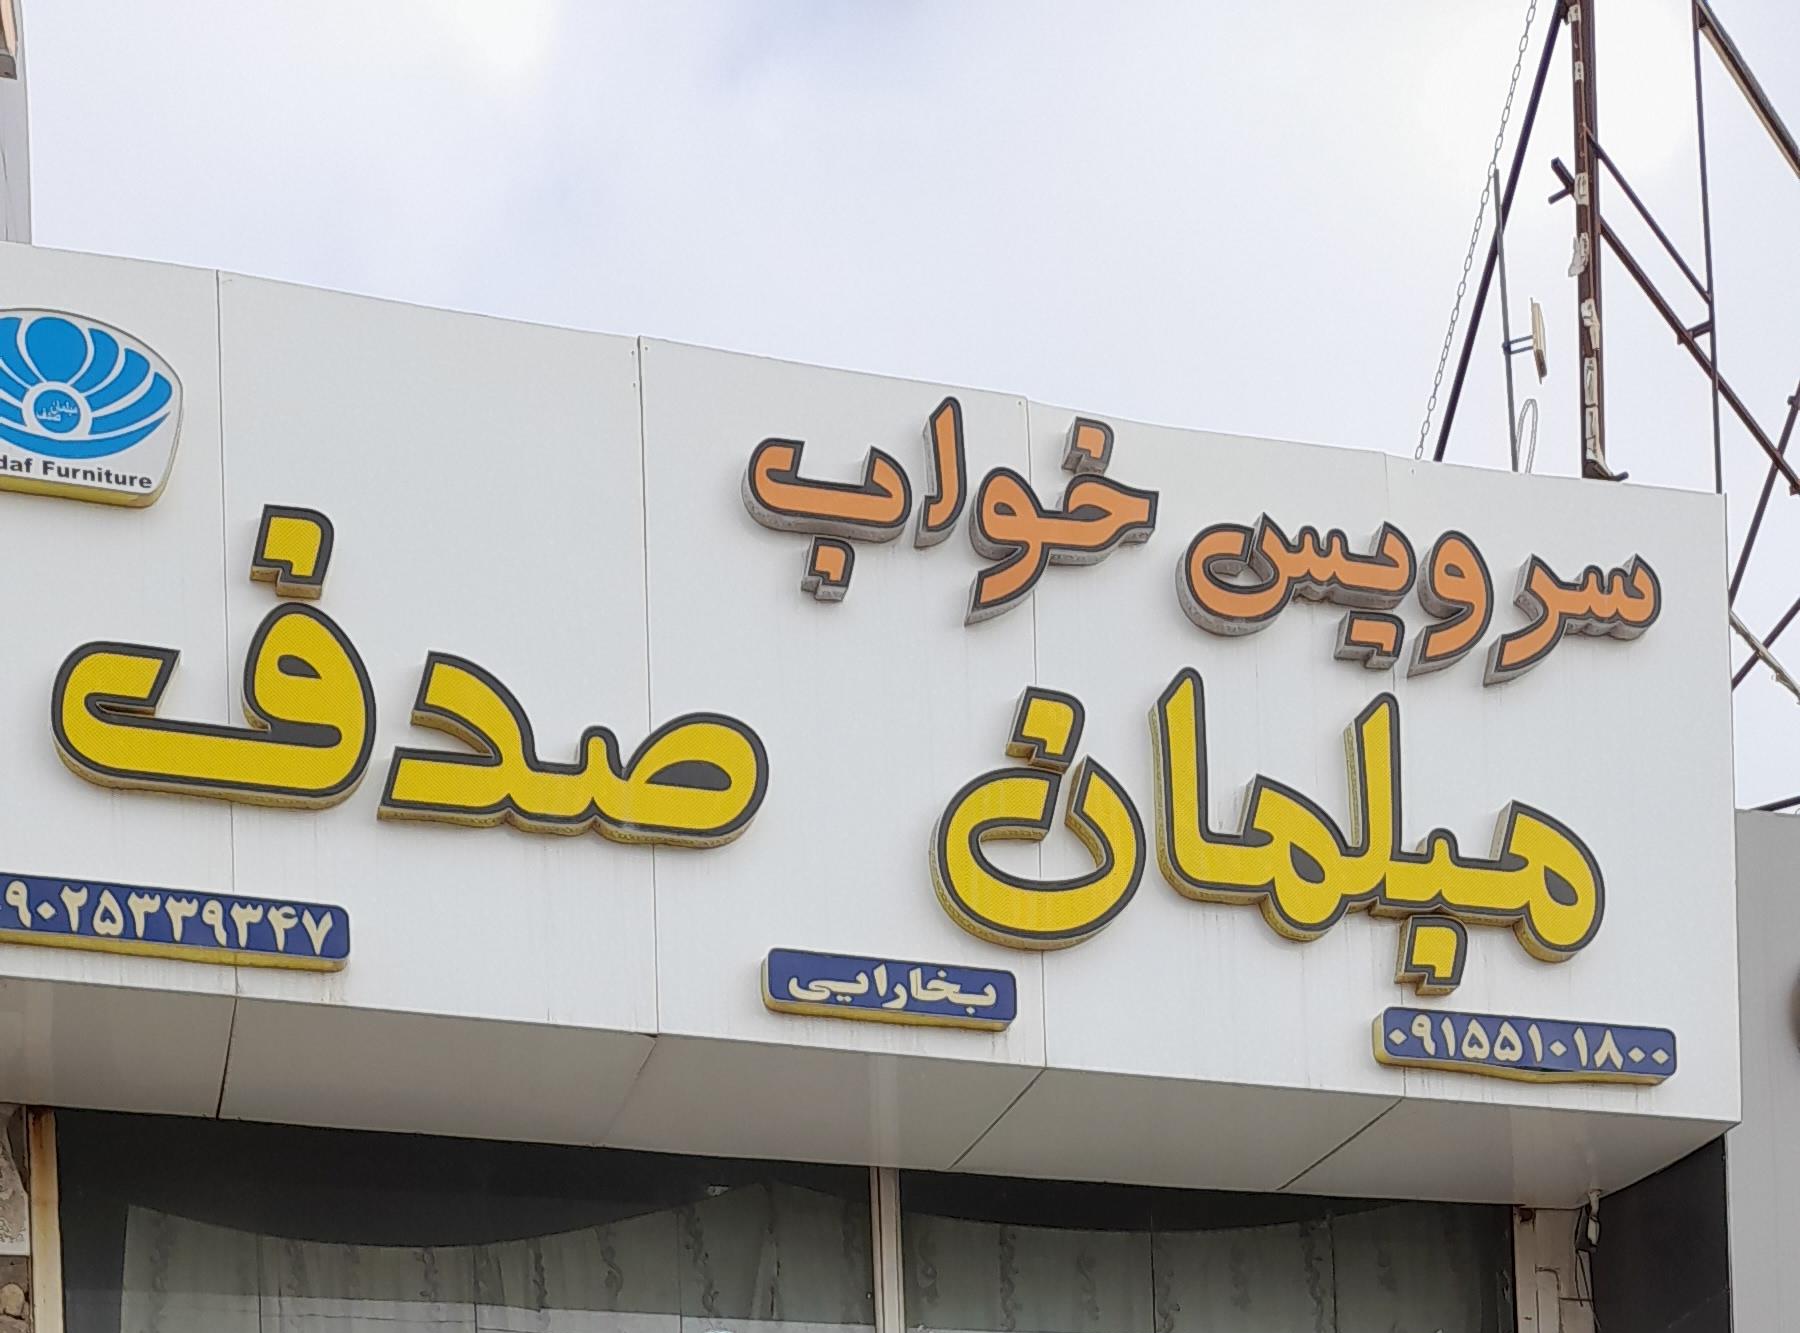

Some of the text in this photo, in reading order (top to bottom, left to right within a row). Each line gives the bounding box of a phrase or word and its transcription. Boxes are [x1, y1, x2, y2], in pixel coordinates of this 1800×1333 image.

[43, 460, 152, 489] Furniture
[744, 396, 1661, 682] سرویس خواب
[51, 505, 1605, 990] مبلمان صدف
[0, 880, 333, 955] ۹۰۲۵۳۳۹۳۴۷
[788, 963, 997, 1015] بخارایی
[1388, 1013, 1671, 1071] ۰۹۱۵۵۱۰۱۸۰۰
